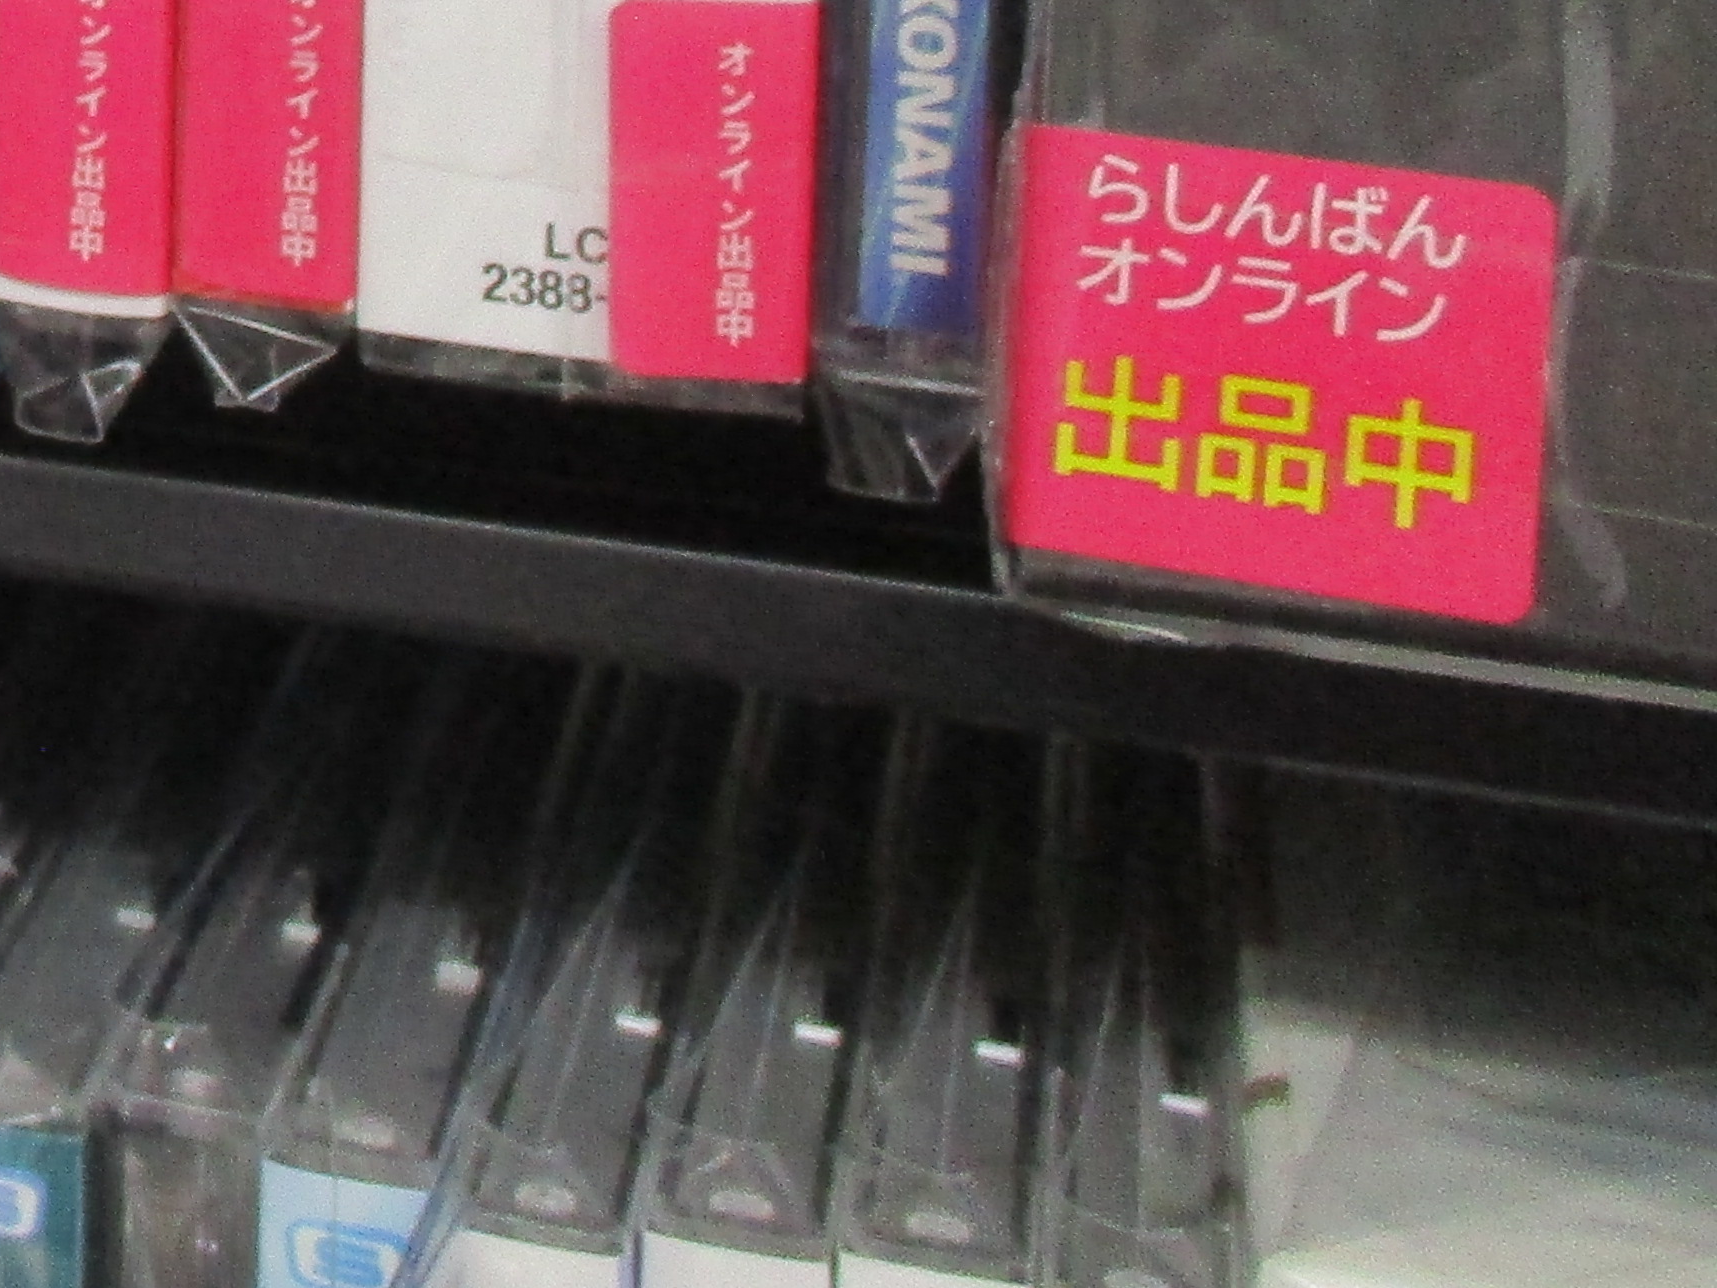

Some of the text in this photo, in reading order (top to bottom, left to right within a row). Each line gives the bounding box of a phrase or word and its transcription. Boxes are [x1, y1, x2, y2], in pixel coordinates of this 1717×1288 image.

[713, 40, 756, 346] オンライン出品中
[1086, 152, 1468, 270] らしんばん
[1075, 236, 1448, 343] オンライン
[1053, 353, 1475, 530] 出品中
